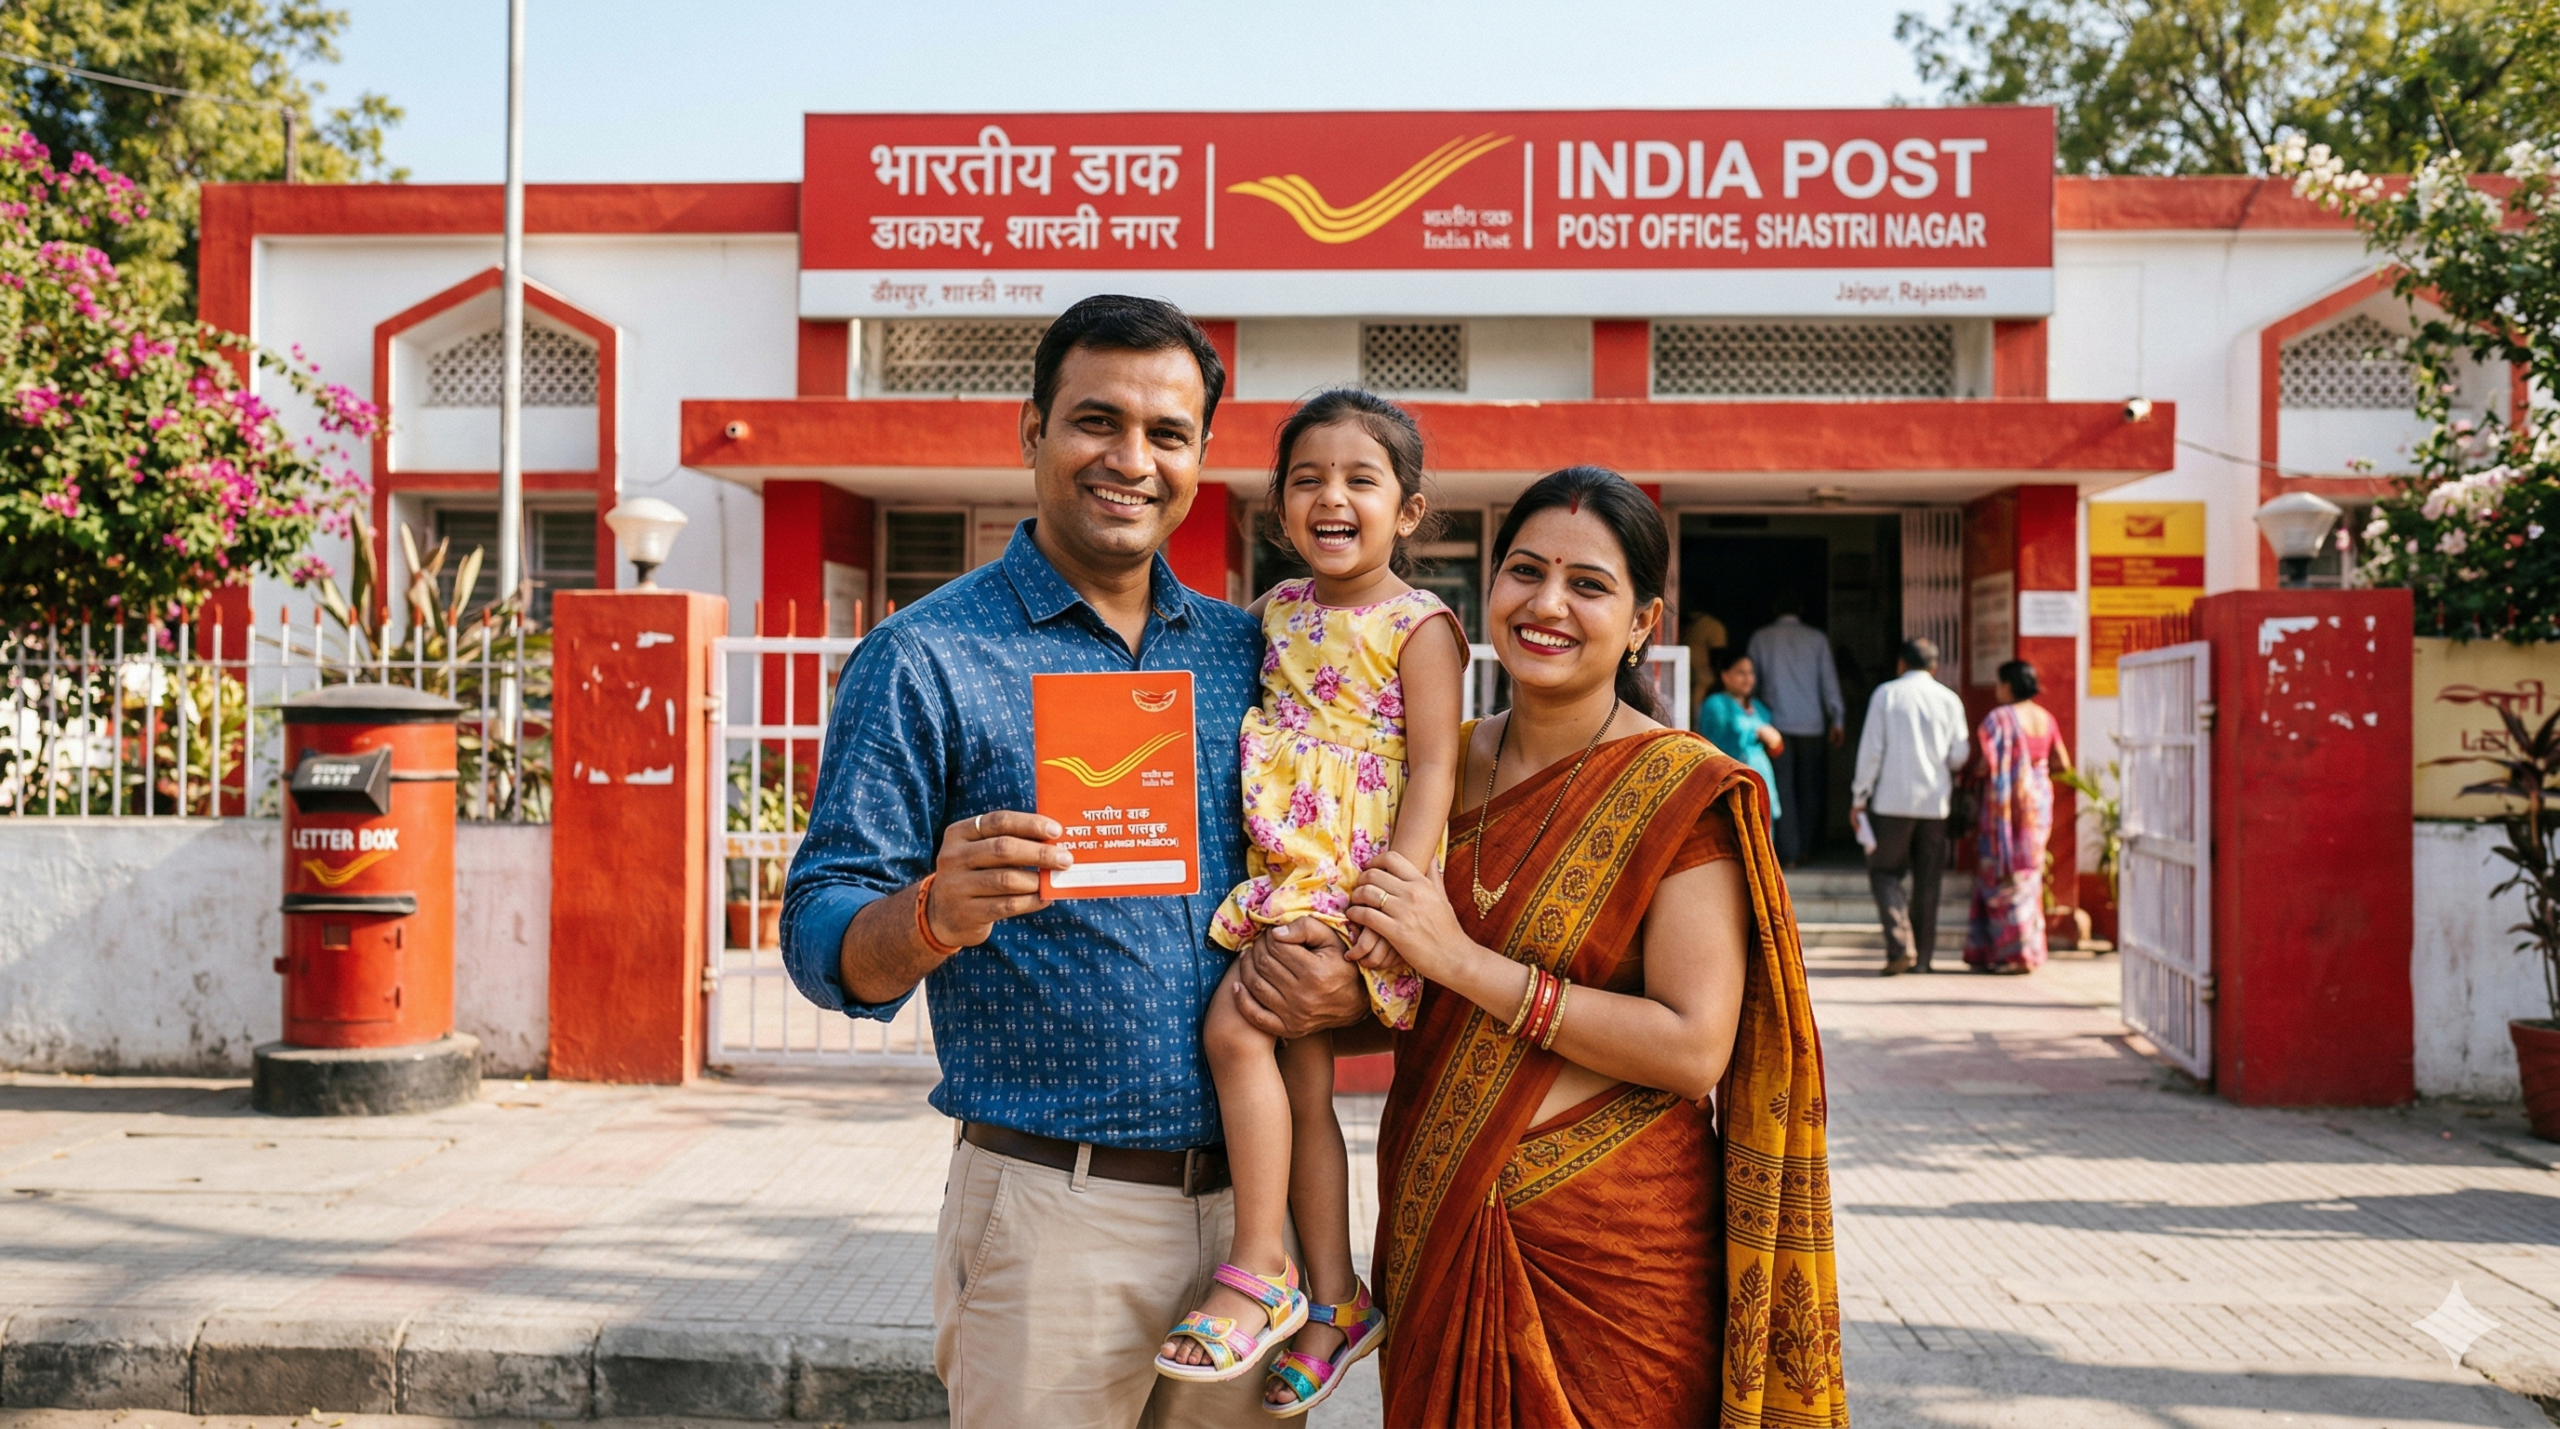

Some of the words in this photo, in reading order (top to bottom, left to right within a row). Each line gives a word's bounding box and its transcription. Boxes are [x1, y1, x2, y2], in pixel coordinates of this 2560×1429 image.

[870, 125, 1057, 196] भारतीय
[1069, 145, 1183, 196] डाक
[1558, 140, 1763, 200] INDIA
[1783, 138, 1988, 200] POST
[870, 216, 993, 256] डाकघर,
[1006, 204, 1103, 250] शास्त्री
[1110, 215, 1181, 250] नगर
[1557, 213, 1634, 250] POST
[1639, 213, 1749, 254] OFFICE,
[1755, 212, 1878, 249] SHASTRI
[1884, 212, 1987, 248] NAGAR
[1004, 284, 1045, 303] नगर
[1835, 281, 1894, 306] Jaipur,
[1899, 281, 1987, 307] Rajasthan
[292, 828, 354, 850] LETTER
[359, 828, 399, 851] BOX
